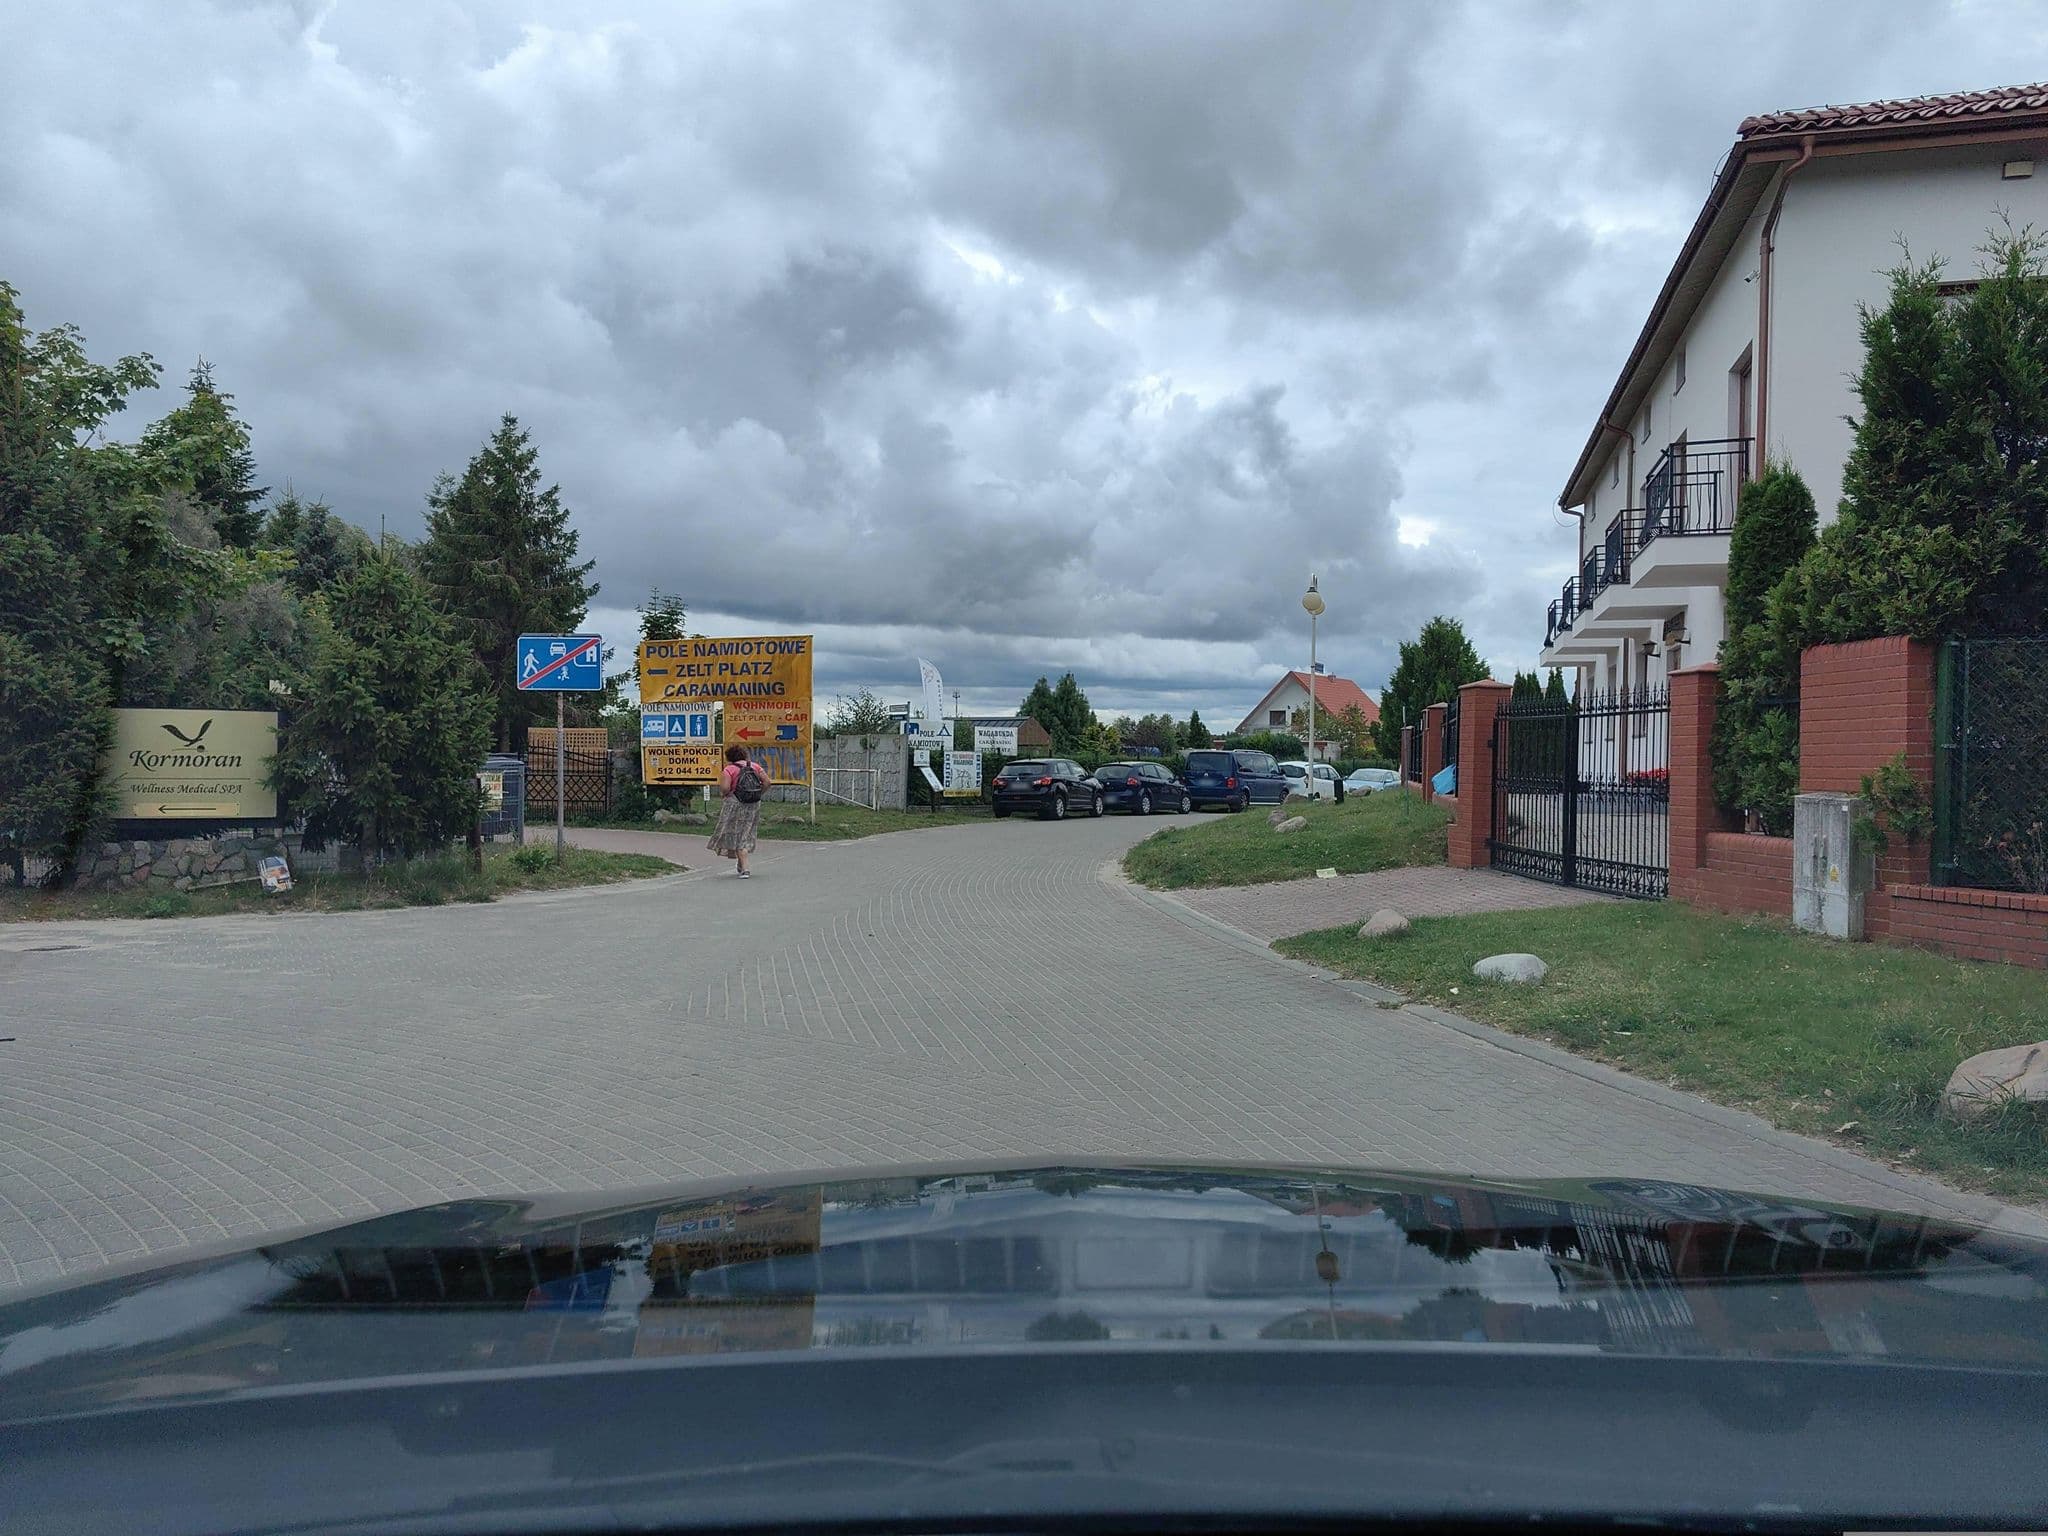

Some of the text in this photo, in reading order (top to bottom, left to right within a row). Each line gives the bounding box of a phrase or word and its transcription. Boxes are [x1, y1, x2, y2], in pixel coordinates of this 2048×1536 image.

[645, 640, 807, 659] POLE NAMIOTOWE
[675, 661, 773, 678] ZELT PLATZ
[664, 681, 786, 697] CARAWANING
[642, 702, 712, 713] POLE NAMIOTOWE
[733, 701, 801, 710] WOHNMOBIL
[729, 714, 747, 722] ZELT
[785, 713, 809, 722] CAR
[919, 730, 935, 738] POLE
[647, 748, 720, 756] WOLNE POKOJE
[129, 750, 242, 772] Kormoran
[668, 757, 699, 765] DOMKI
[657, 767, 711, 775] 512 044 126
[131, 783, 243, 795] Wellness Medical SPA
